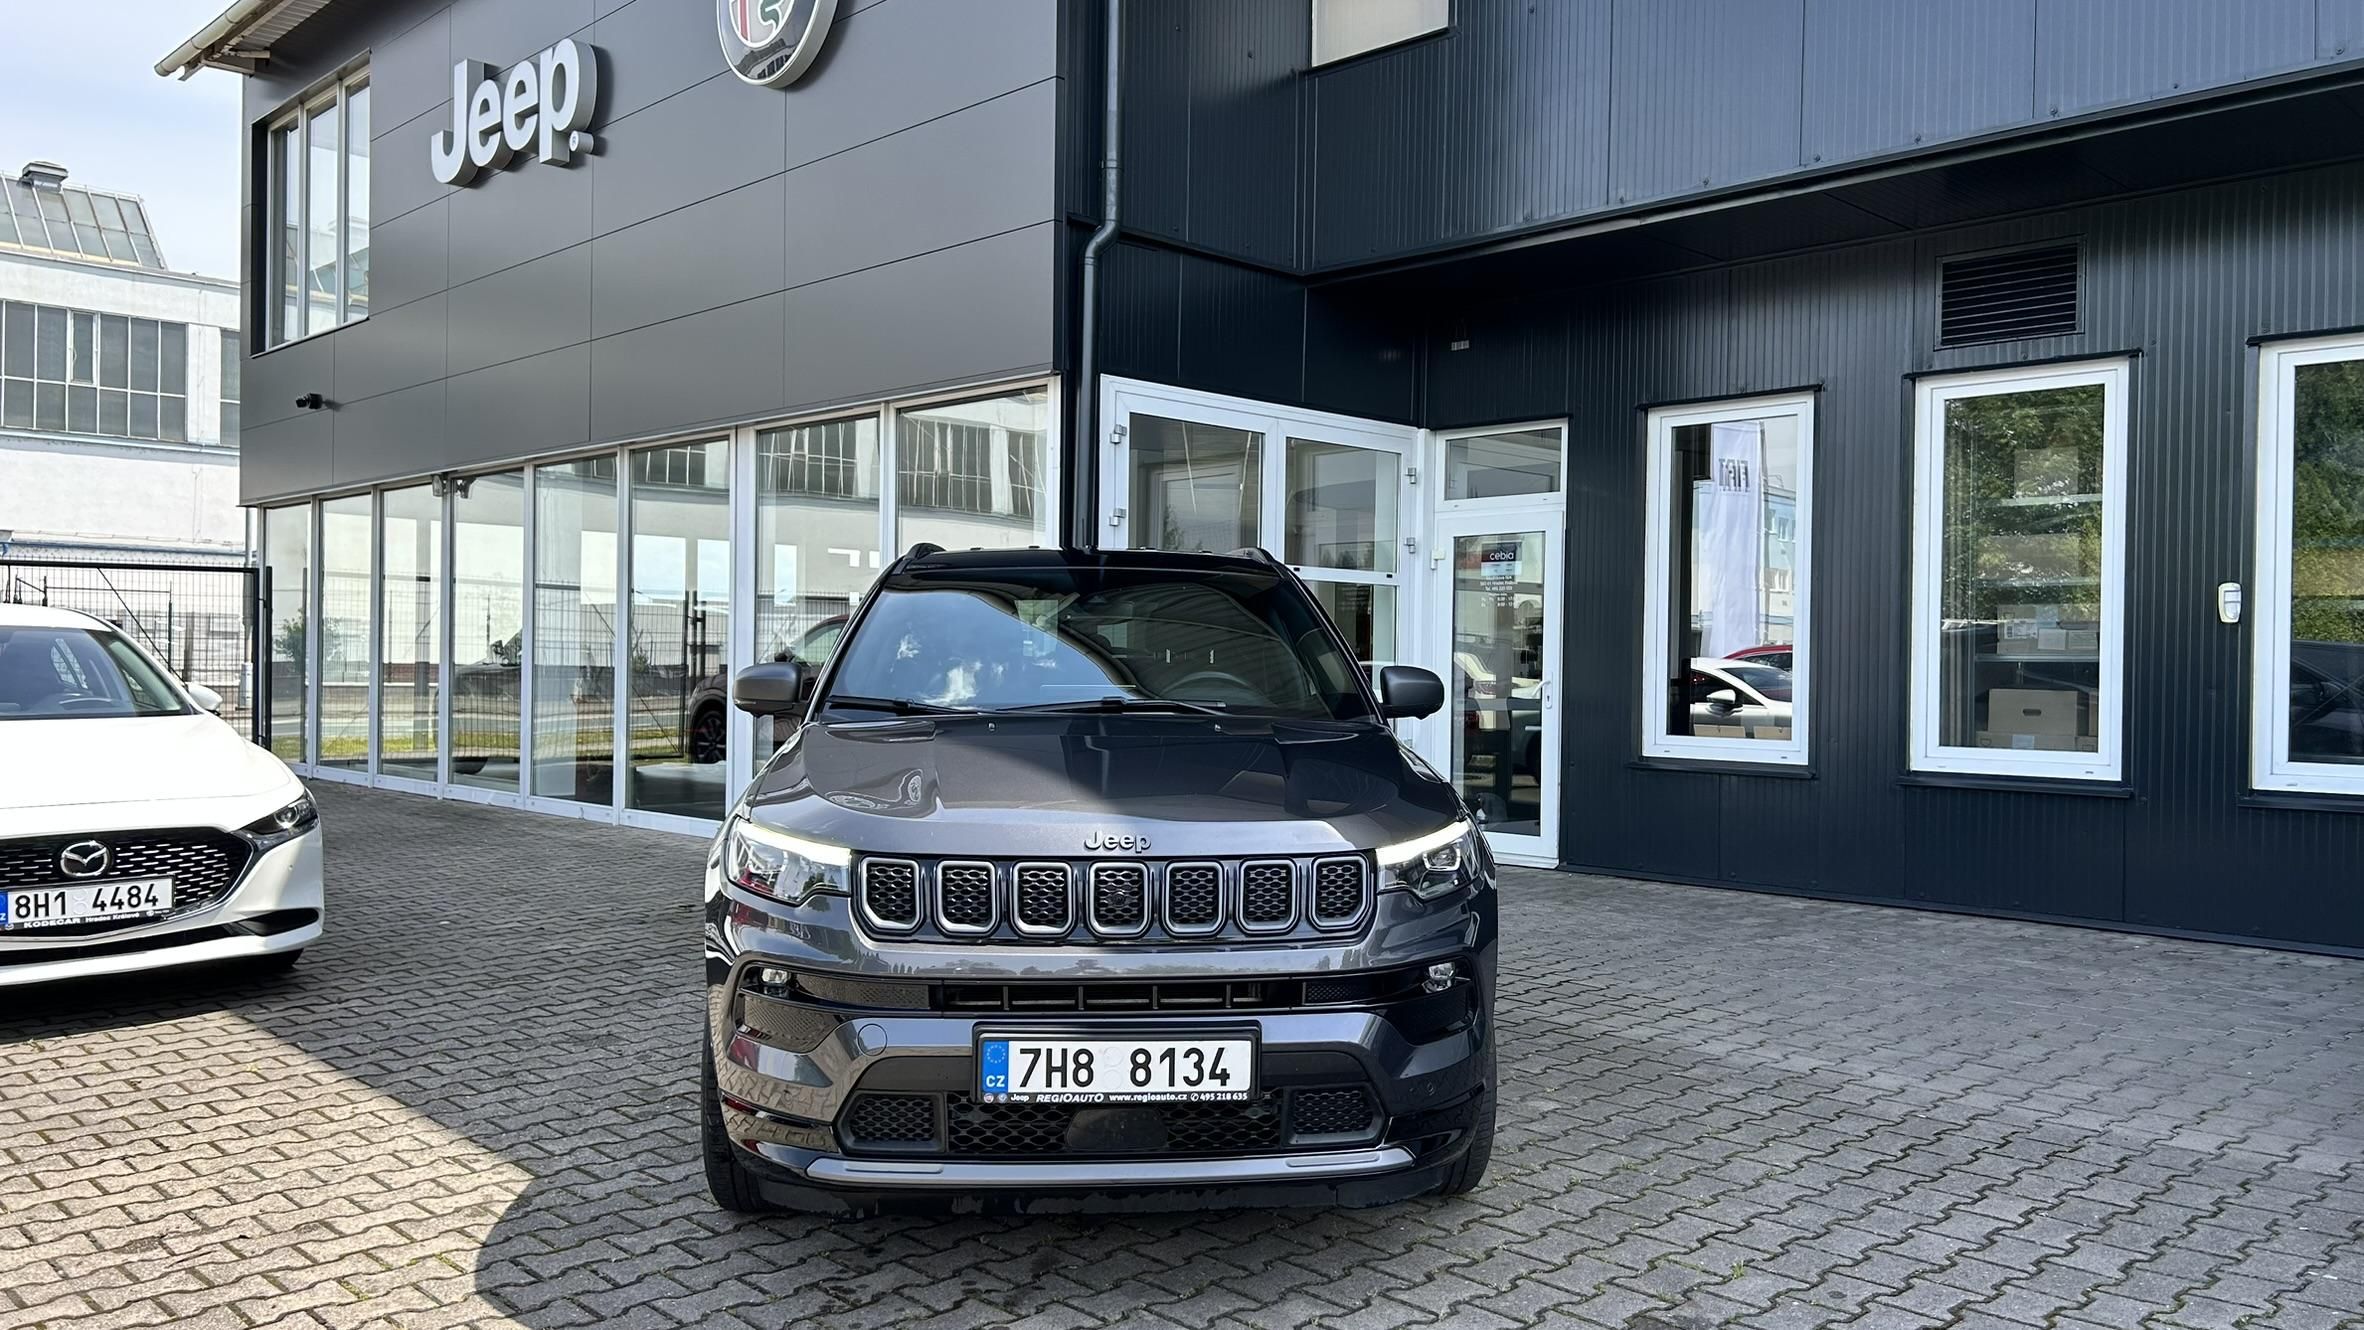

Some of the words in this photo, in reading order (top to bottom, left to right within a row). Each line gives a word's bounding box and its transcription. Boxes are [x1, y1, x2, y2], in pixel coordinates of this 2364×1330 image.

[431, 38, 590, 184] Jeep
[1489, 551, 1514, 560] cebia
[1084, 831, 1151, 853] Jeep
[15, 891, 66, 919] 8H1
[92, 884, 158, 911] 4484
[24, 918, 81, 928] KODECAR
[986, 1076, 1005, 1087] CZ
[1019, 1048, 1094, 1088] 7H8
[1130, 1047, 1230, 1087] 8134
[1010, 1093, 1030, 1102] Jeep
[1036, 1093, 1104, 1102] REGIOAUTO
[1109, 1093, 1188, 1102] www.regioauto.cz
[1200, 1093, 1215, 1101] 495
[1216, 1092, 1231, 1101] 218
[1233, 1092, 1248, 1100] 635
